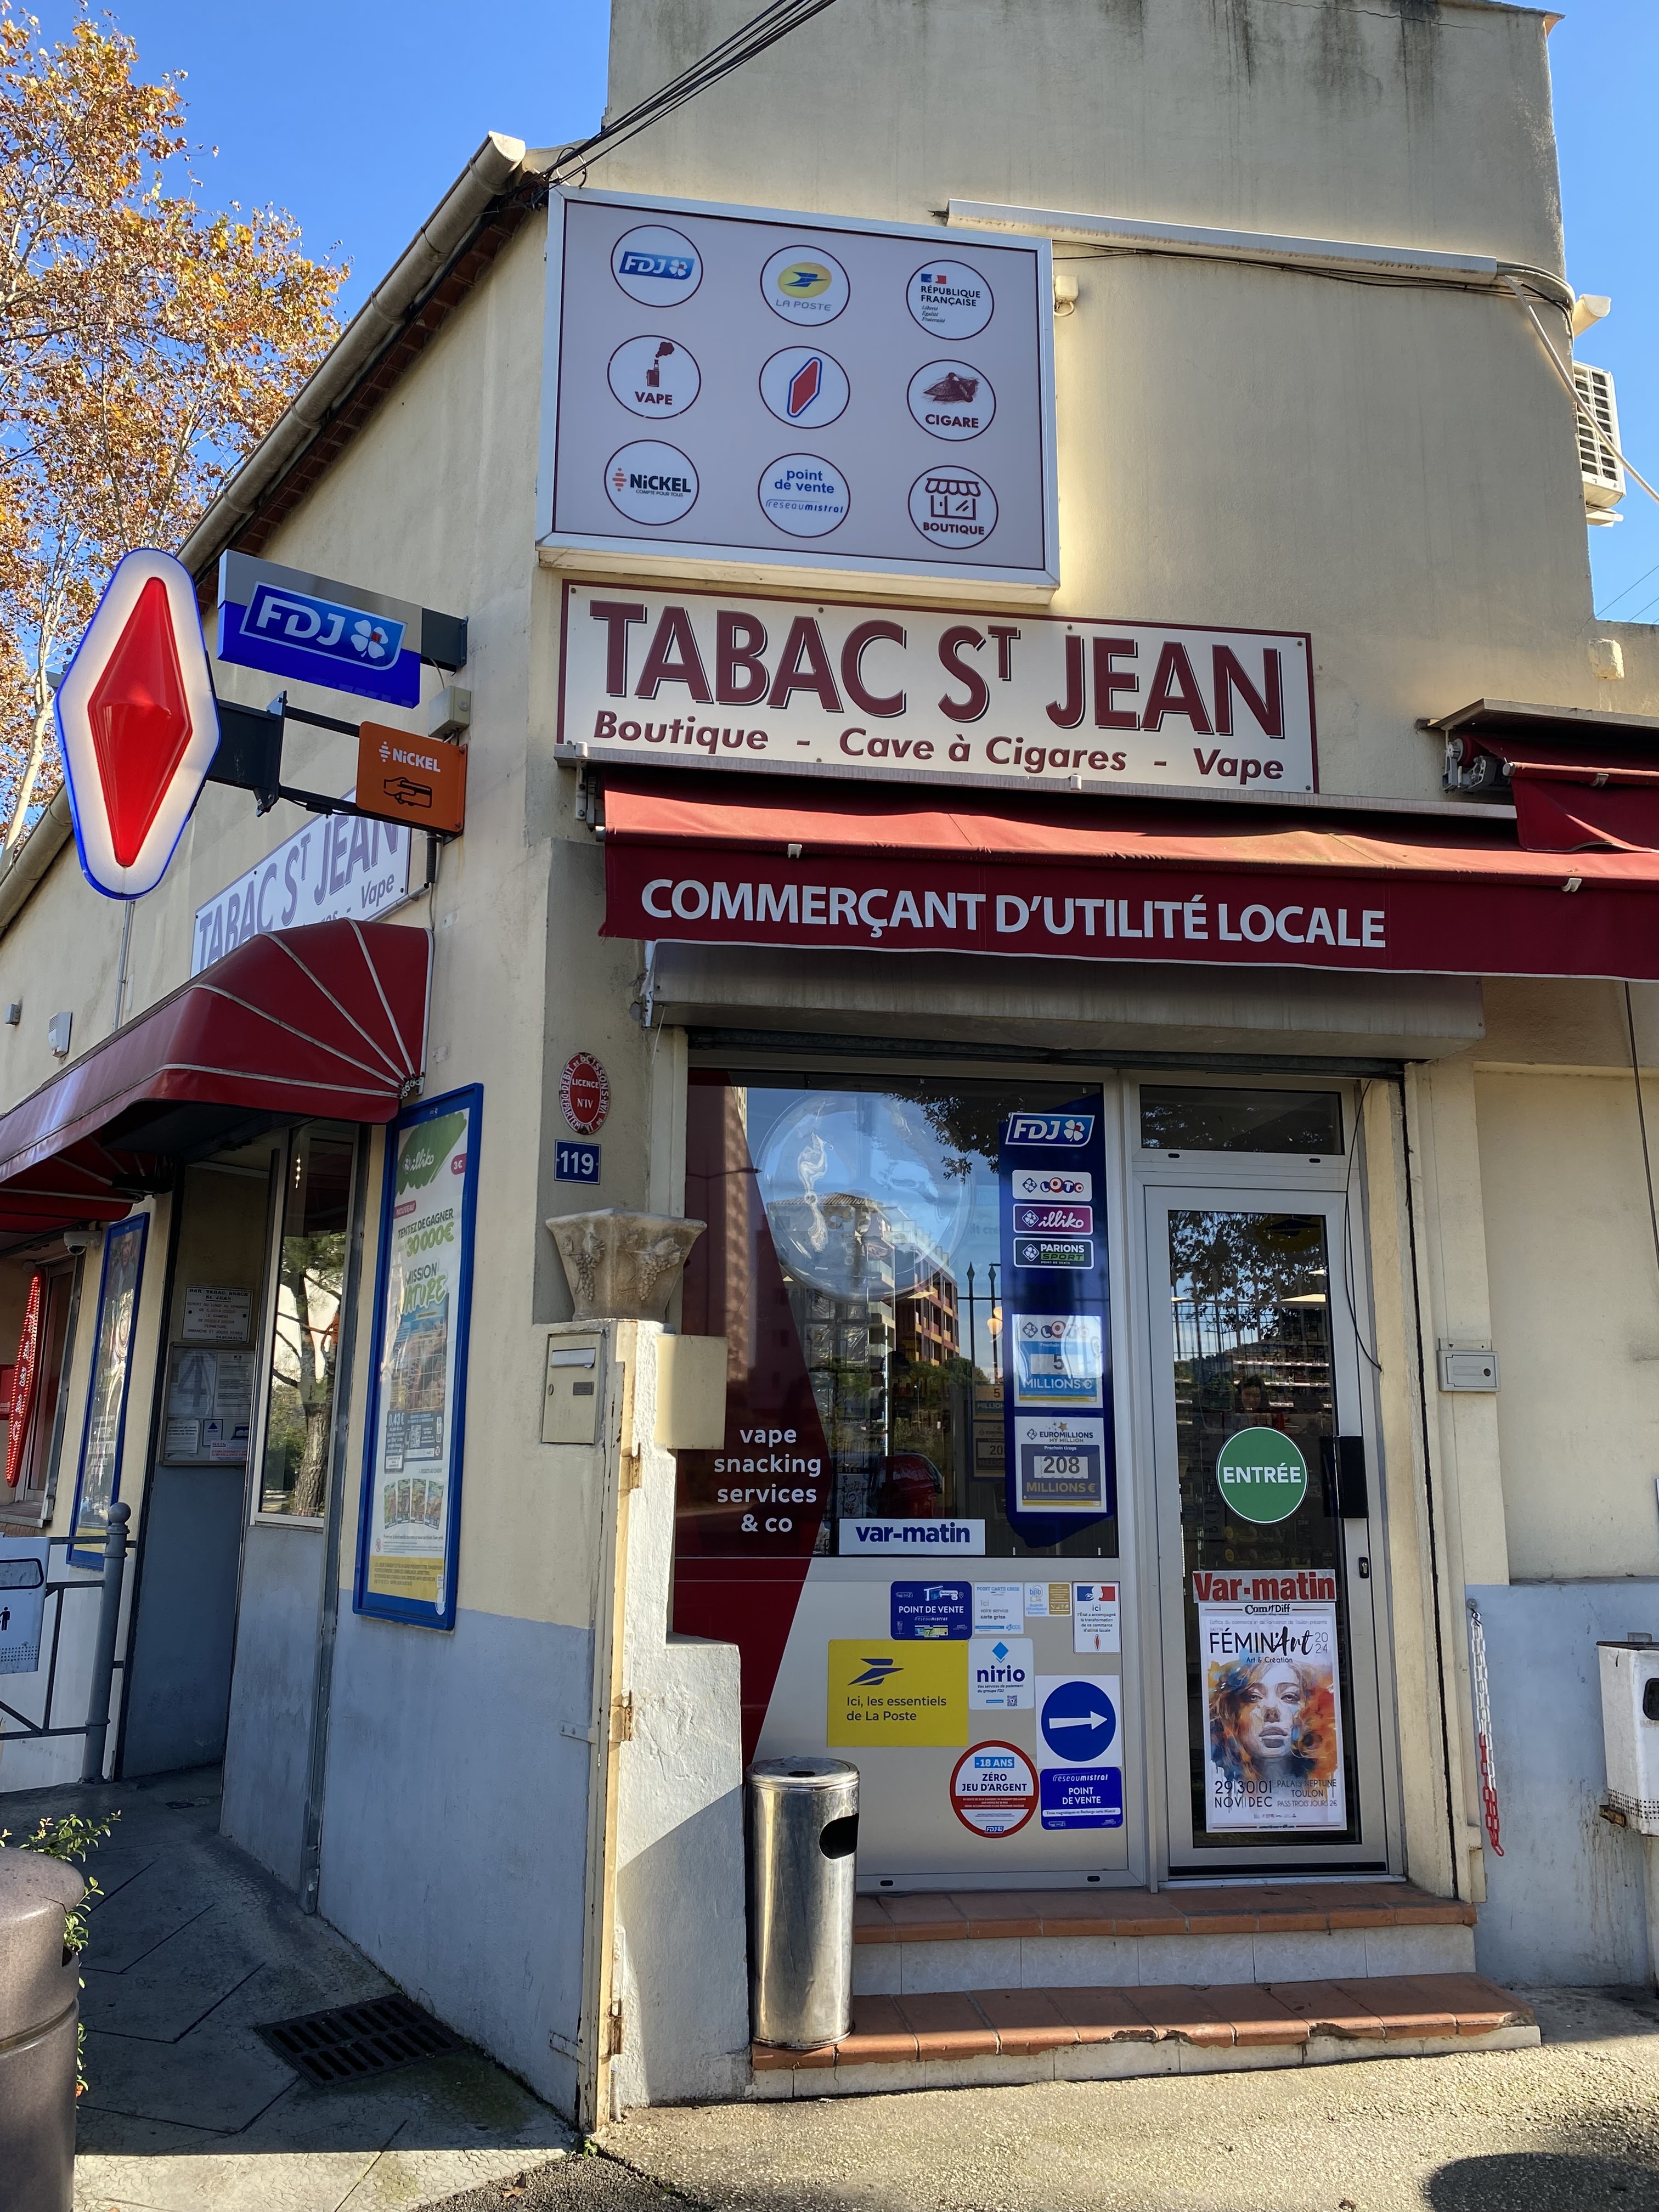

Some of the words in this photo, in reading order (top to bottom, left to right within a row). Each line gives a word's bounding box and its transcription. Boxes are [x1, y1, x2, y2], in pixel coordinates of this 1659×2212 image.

[624, 256, 666, 274] FDJ
[921, 285, 980, 298] RÉPUBLIQUE
[776, 299, 791, 308] LA
[794, 301, 832, 311] POSTE
[921, 295, 977, 307] FRANÇAISE
[635, 391, 673, 405] VAPE
[925, 413, 979, 428] CIGARE
[787, 469, 823, 482] point
[775, 479, 791, 490] de
[796, 481, 834, 494] vente
[923, 522, 984, 536] BOUTIQUE
[256, 595, 346, 646] FDJ
[590, 600, 907, 718] TABAC
[1046, 634, 1285, 740] JEAN
[594, 710, 769, 754] Boutique
[839, 727, 934, 760] Cave
[948, 734, 971, 762] à
[986, 736, 1127, 774] Cigares
[1193, 748, 1284, 785] Vape
[361, 873, 395, 909] Vape
[641, 879, 986, 938] COMMERÇANT
[1218, 903, 1386, 948] LOCALE
[561, 1064, 574, 1091] DEBIT
[599, 1099, 609, 1115] VAR
[572, 1079, 600, 1089] LICENCE
[1013, 1119, 1060, 1140] FDJ
[410, 1148, 435, 1171] illiko
[453, 1159, 463, 1170] 3€
[561, 1150, 594, 1175] 119
[1040, 1177, 1084, 1193] LOTO
[398, 1221, 417, 1239] TENTEZ
[418, 1218, 426, 1231] DE
[426, 1208, 454, 1227] GAGNER
[1038, 1210, 1084, 1228] illiko
[1040, 1244, 1085, 1253] PARIONS
[1053, 1354, 1065, 1370] 5
[1024, 1378, 1081, 1389] MILLIONS
[1082, 1379, 1093, 1390] €
[994, 1388, 1001, 1398] 5
[740, 1428, 797, 1447] vape
[714, 1454, 822, 1477] snacking
[1043, 1456, 1080, 1474] 208
[1223, 1463, 1301, 1483] ENTRÉE
[717, 1483, 817, 1503] services
[1026, 1482, 1086, 1493] MILLIONS
[1088, 1483, 1096, 1492] €
[741, 1514, 758, 1532] &
[765, 1517, 792, 1532] co
[855, 1522, 970, 1543] var-matin
[1314, 1632, 1328, 1643] 20
[1316, 1644, 1328, 1654] 24
[977, 1664, 1025, 1683] nirio
[847, 1696, 864, 1708] Ici,
[867, 1696, 884, 1706] les
[887, 1695, 947, 1706] essentiels
[847, 1711, 862, 1721] de
[866, 1711, 879, 1721] La
[883, 1711, 917, 1721] Poste
[975, 1758, 992, 1767] -18
[993, 1758, 1013, 1767] ANS
[981, 1771, 1007, 1781] ZÉRO
[1305, 1779, 1337, 1787] NEPTUNE
[962, 1784, 979, 1792] JEU
[1069, 1787, 1093, 1795] POINT
[1075, 1796, 1101, 1804] VENTE
[1215, 1797, 1243, 1808] NOV
[1249, 1796, 1273, 1807] DEC
